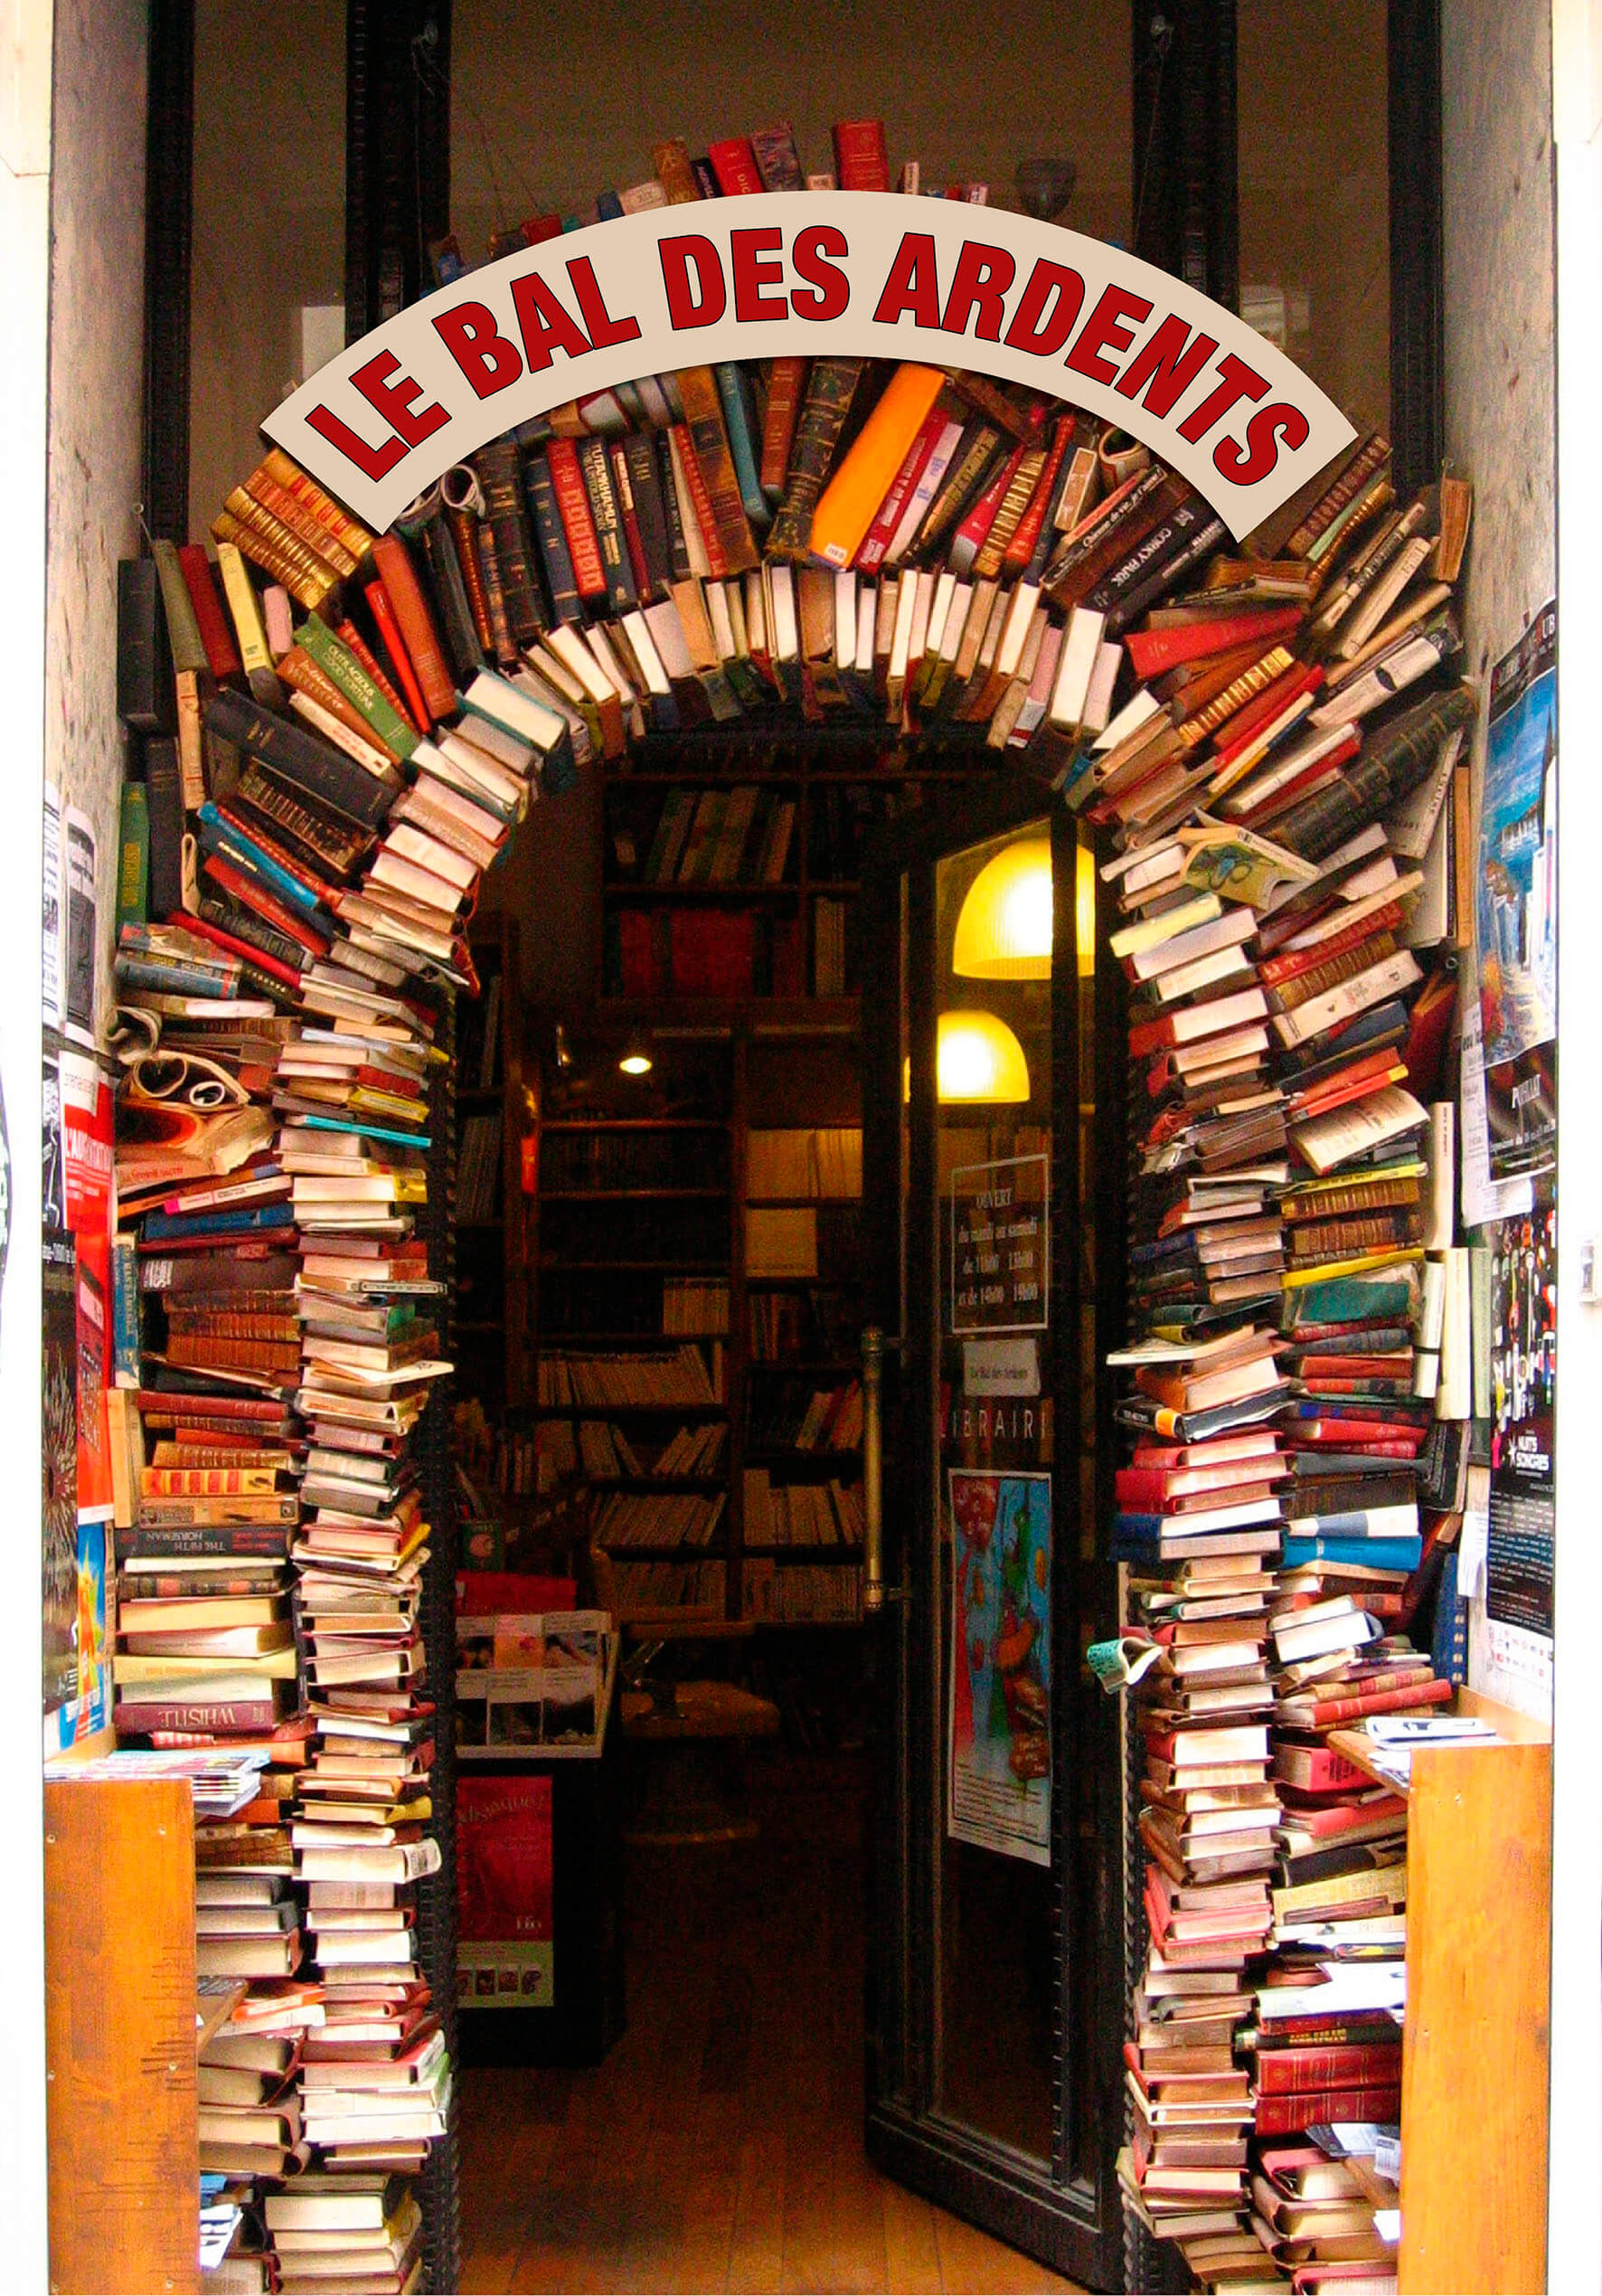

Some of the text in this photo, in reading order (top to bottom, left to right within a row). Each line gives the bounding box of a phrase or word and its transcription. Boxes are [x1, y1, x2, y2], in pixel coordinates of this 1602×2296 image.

[304, 348, 453, 483] LE
[430, 255, 643, 400] BAL
[657, 224, 850, 331] DES
[872, 231, 1310, 487] ARDENTS
[590, 442, 618, 529] TUTANKHAMUN
[1110, 556, 1142, 587] PARK
[157, 1707, 237, 1728] WHISTLE
